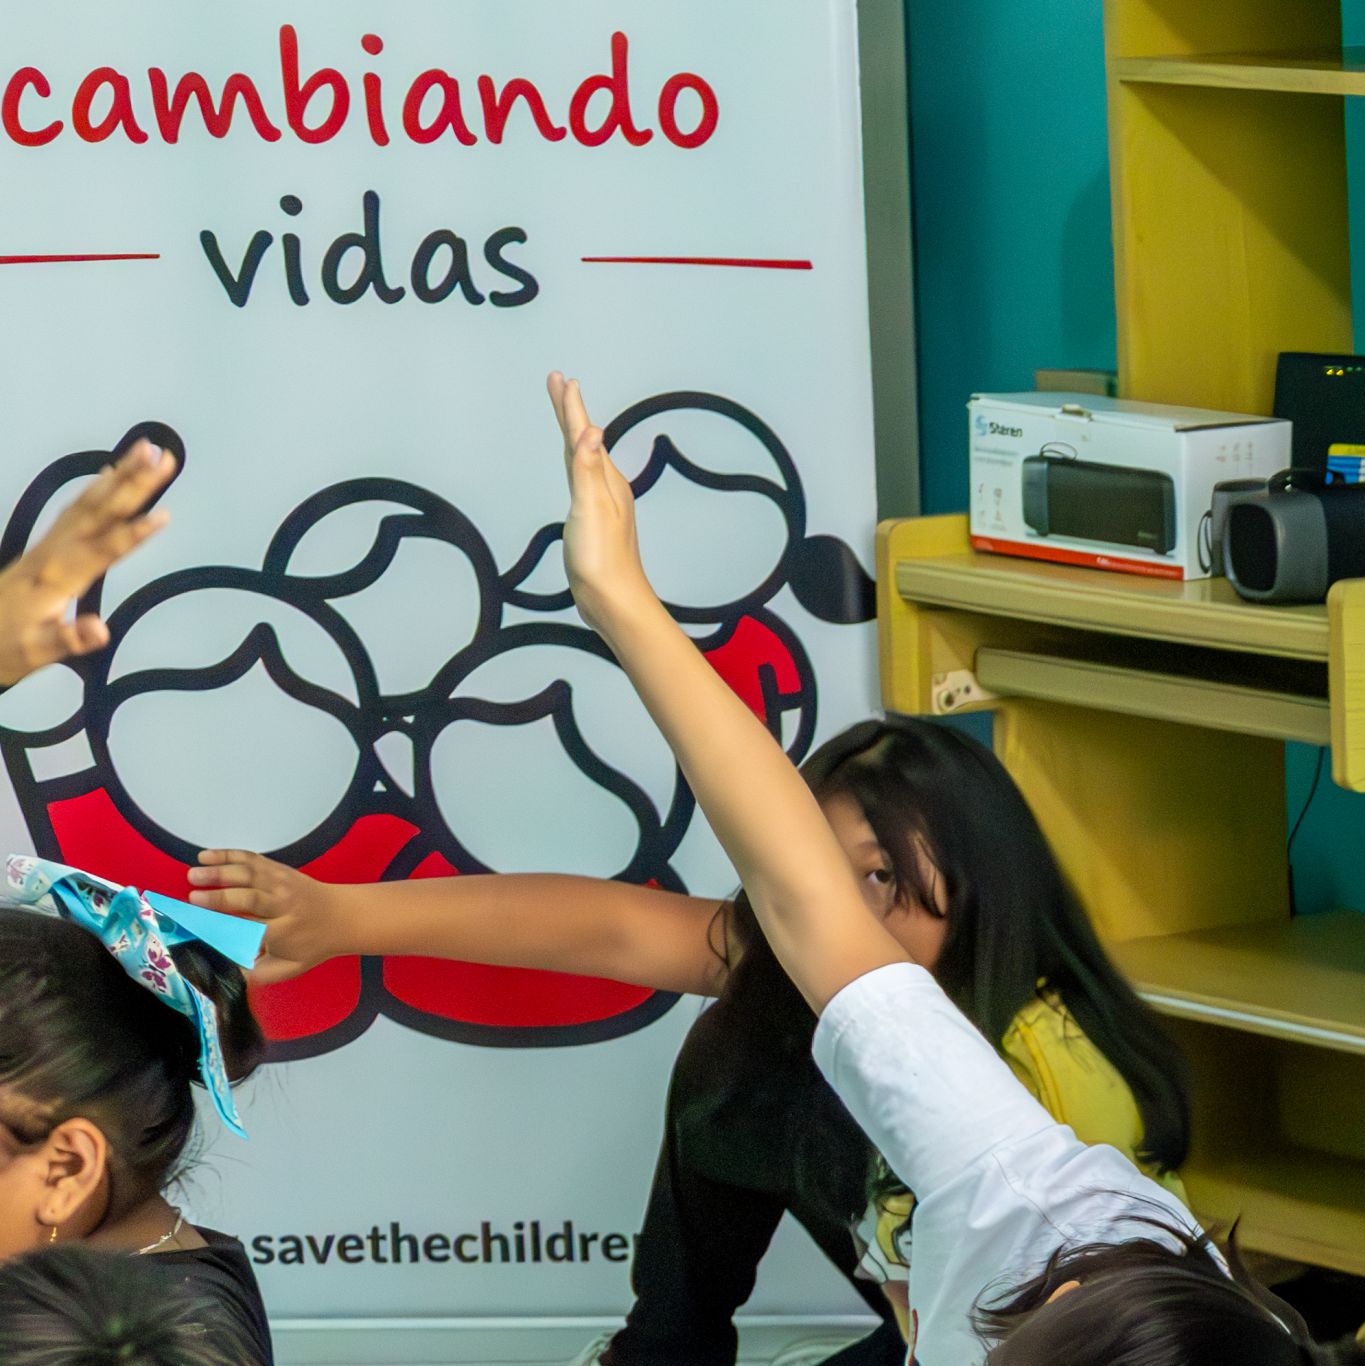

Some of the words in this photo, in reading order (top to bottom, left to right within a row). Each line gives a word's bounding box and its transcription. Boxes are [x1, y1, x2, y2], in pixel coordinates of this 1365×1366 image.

[1, 24, 720, 149] cambiando
[199, 190, 540, 308] vidas
[252, 1220, 645, 1264] savethechildre
